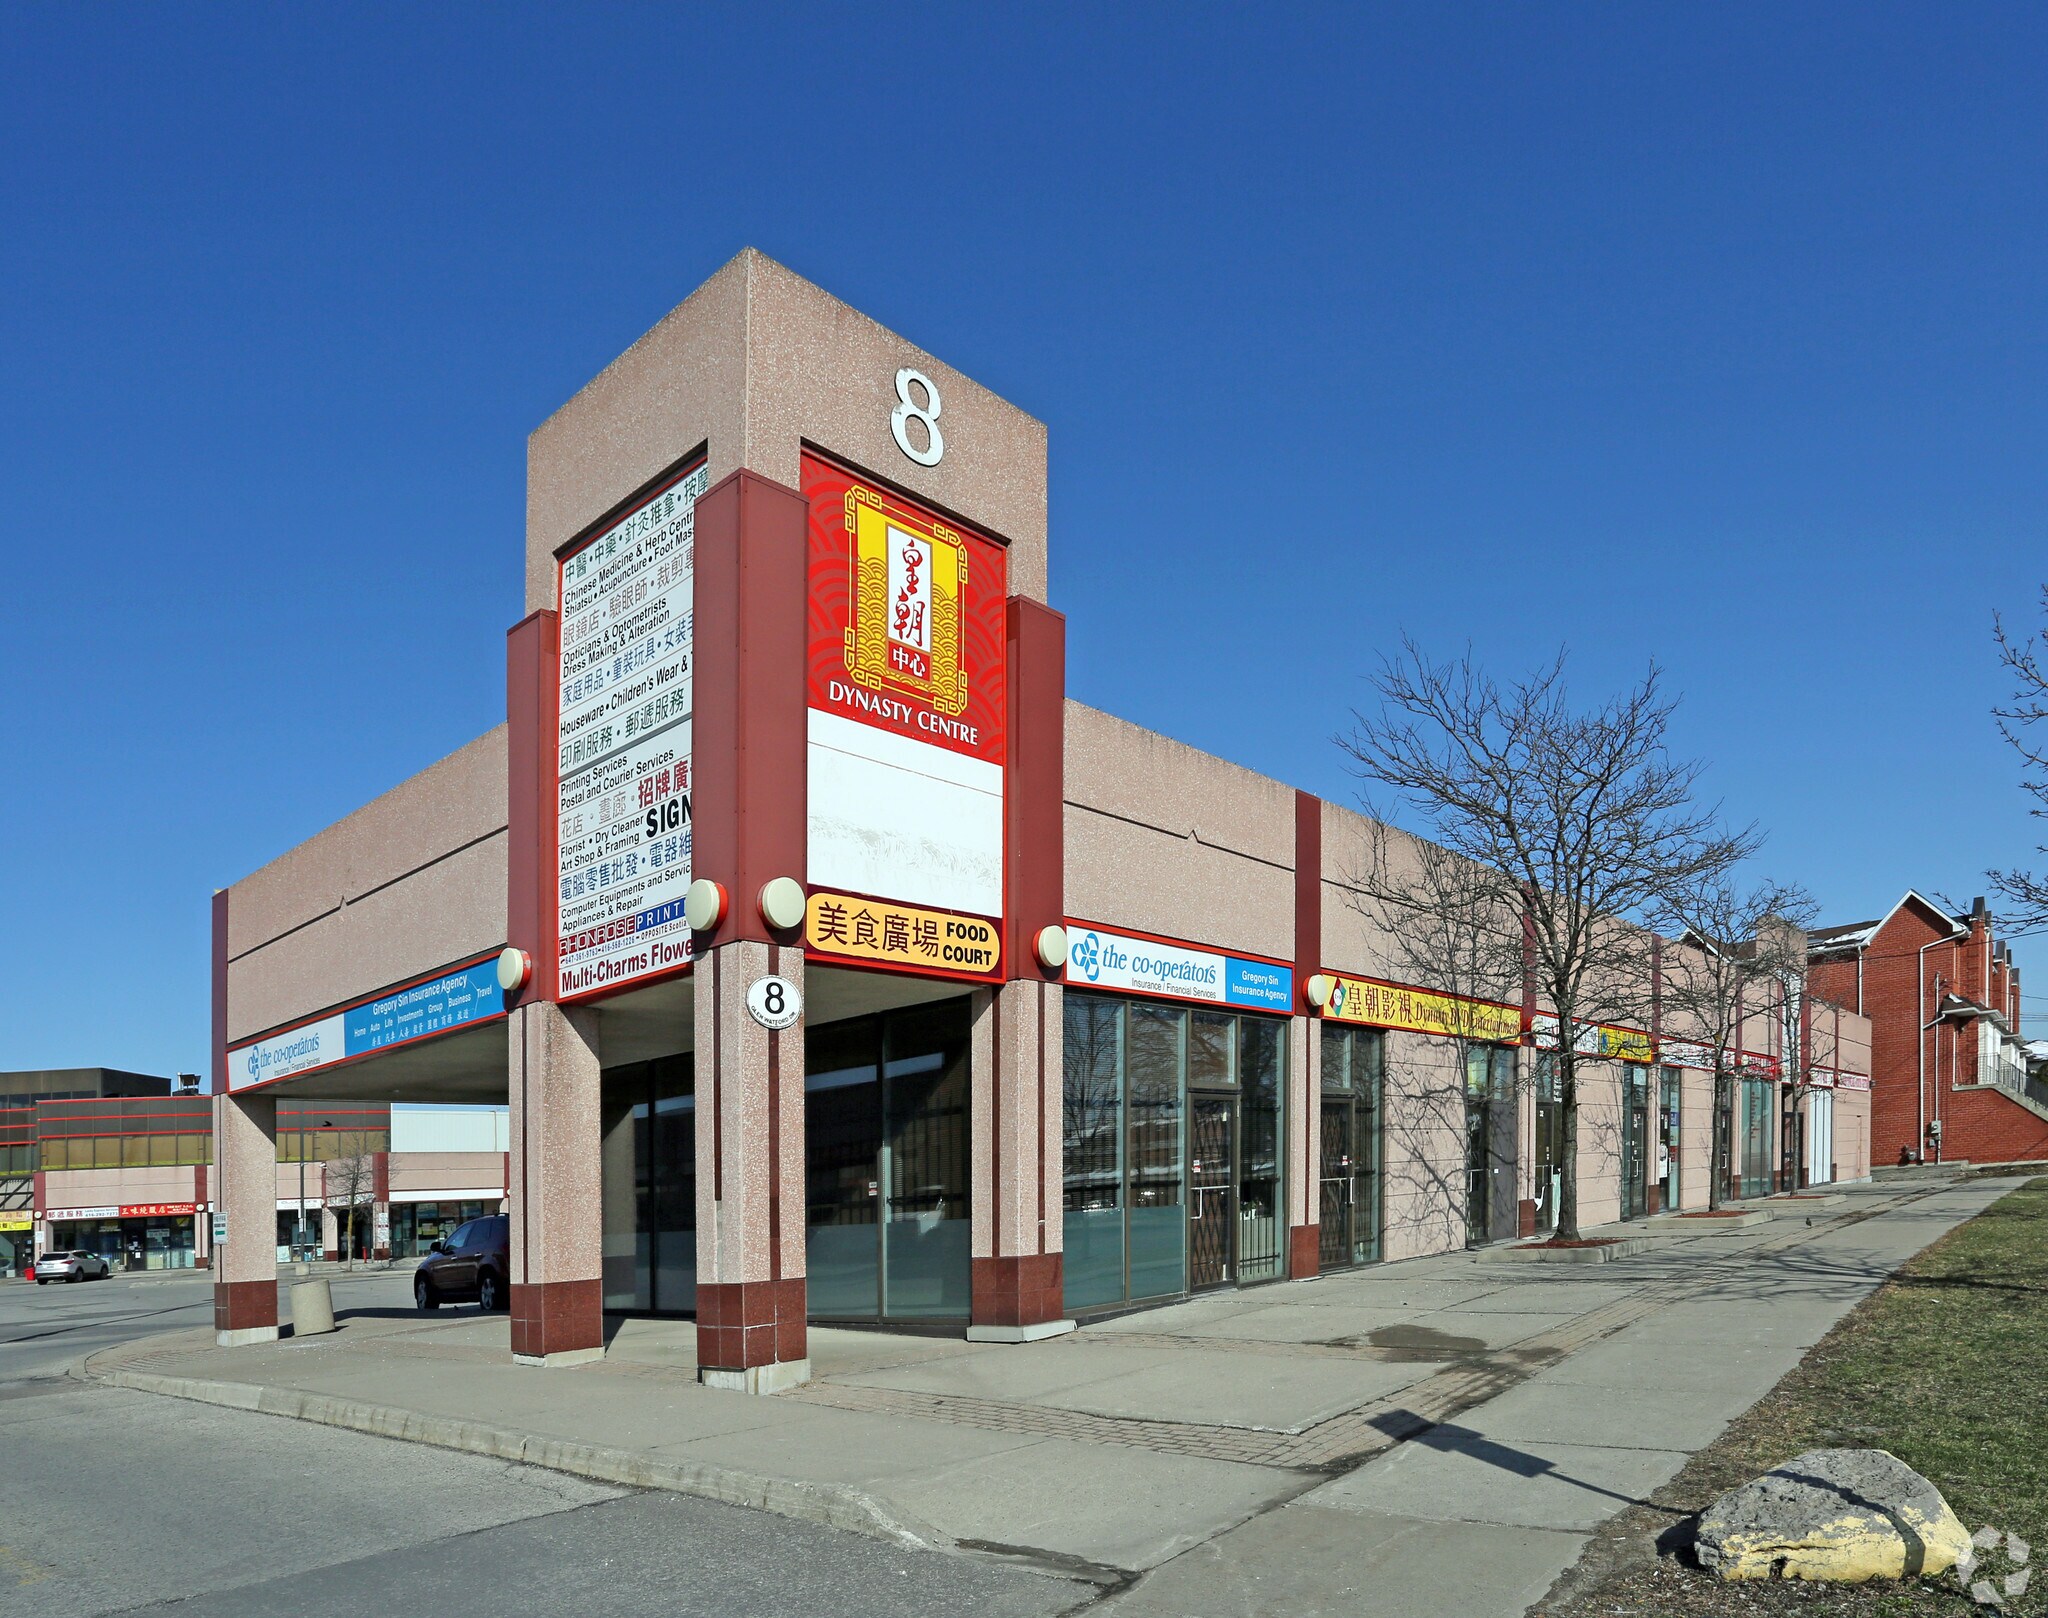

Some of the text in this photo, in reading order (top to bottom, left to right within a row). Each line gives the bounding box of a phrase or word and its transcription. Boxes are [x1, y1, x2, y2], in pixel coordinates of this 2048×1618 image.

[890, 366, 944, 468] 8
[565, 578, 597, 605] Chinese
[599, 552, 633, 583] Medicine
[635, 543, 643, 557] &
[645, 529, 667, 552] Herb
[565, 594, 592, 618] Shiatsu
[599, 558, 647, 597] Acupuncture
[654, 539, 674, 560] Foot
[563, 597, 667, 665] Opticians & Optometrists
[563, 609, 670, 678] Dress Making & Alteration
[893, 647, 926, 678] 中心
[560, 654, 688, 738] Houseware Children's Wear &
[829, 680, 978, 746] DYNASTY CENTRE
[560, 725, 612, 769] 印刷服務
[561, 756, 627, 796] Printing Services
[561, 749, 674, 811] Postal and Courier Services
[561, 812, 583, 839] 花店
[646, 792, 691, 838] SIGN
[561, 815, 644, 858] Florist Dry Cleaner
[561, 832, 640, 872] Art Shop & Framing
[561, 899, 597, 919] Computer
[599, 881, 645, 906] Equipments
[647, 872, 662, 888] and
[562, 895, 643, 932] Appliances & Repair
[640, 925, 668, 940] OPPOSITE
[817, 901, 939, 958] 美食廣場
[946, 922, 989, 943] FOOD
[562, 938, 694, 992] Multi-Charms Flowe
[942, 945, 992, 966] COURT
[1102, 943, 1217, 984] the co-operators
[372, 999, 398, 1015] Gregory
[408, 984, 440, 1003] Insurance
[440, 974, 467, 994] Agency
[765, 982, 785, 1014] 8
[1131, 977, 1161, 991] Insurance
[1166, 982, 1192, 996] Financial
[1192, 986, 1217, 999] Services
[1232, 982, 1287, 1003] Insurance Agency
[1241, 970, 1279, 986] Gregory Sin
[354, 1027, 366, 1037] Home
[370, 1022, 380, 1033] Auto
[384, 1018, 394, 1028] Life
[427, 1002, 443, 1013] Group
[448, 993, 471, 1007] Business
[477, 984, 492, 998] Travel
[1348, 983, 1412, 1024] 皇朝影視
[1416, 1001, 1448, 1029] Dynasty
[260, 1033, 320, 1068] the co-operators
